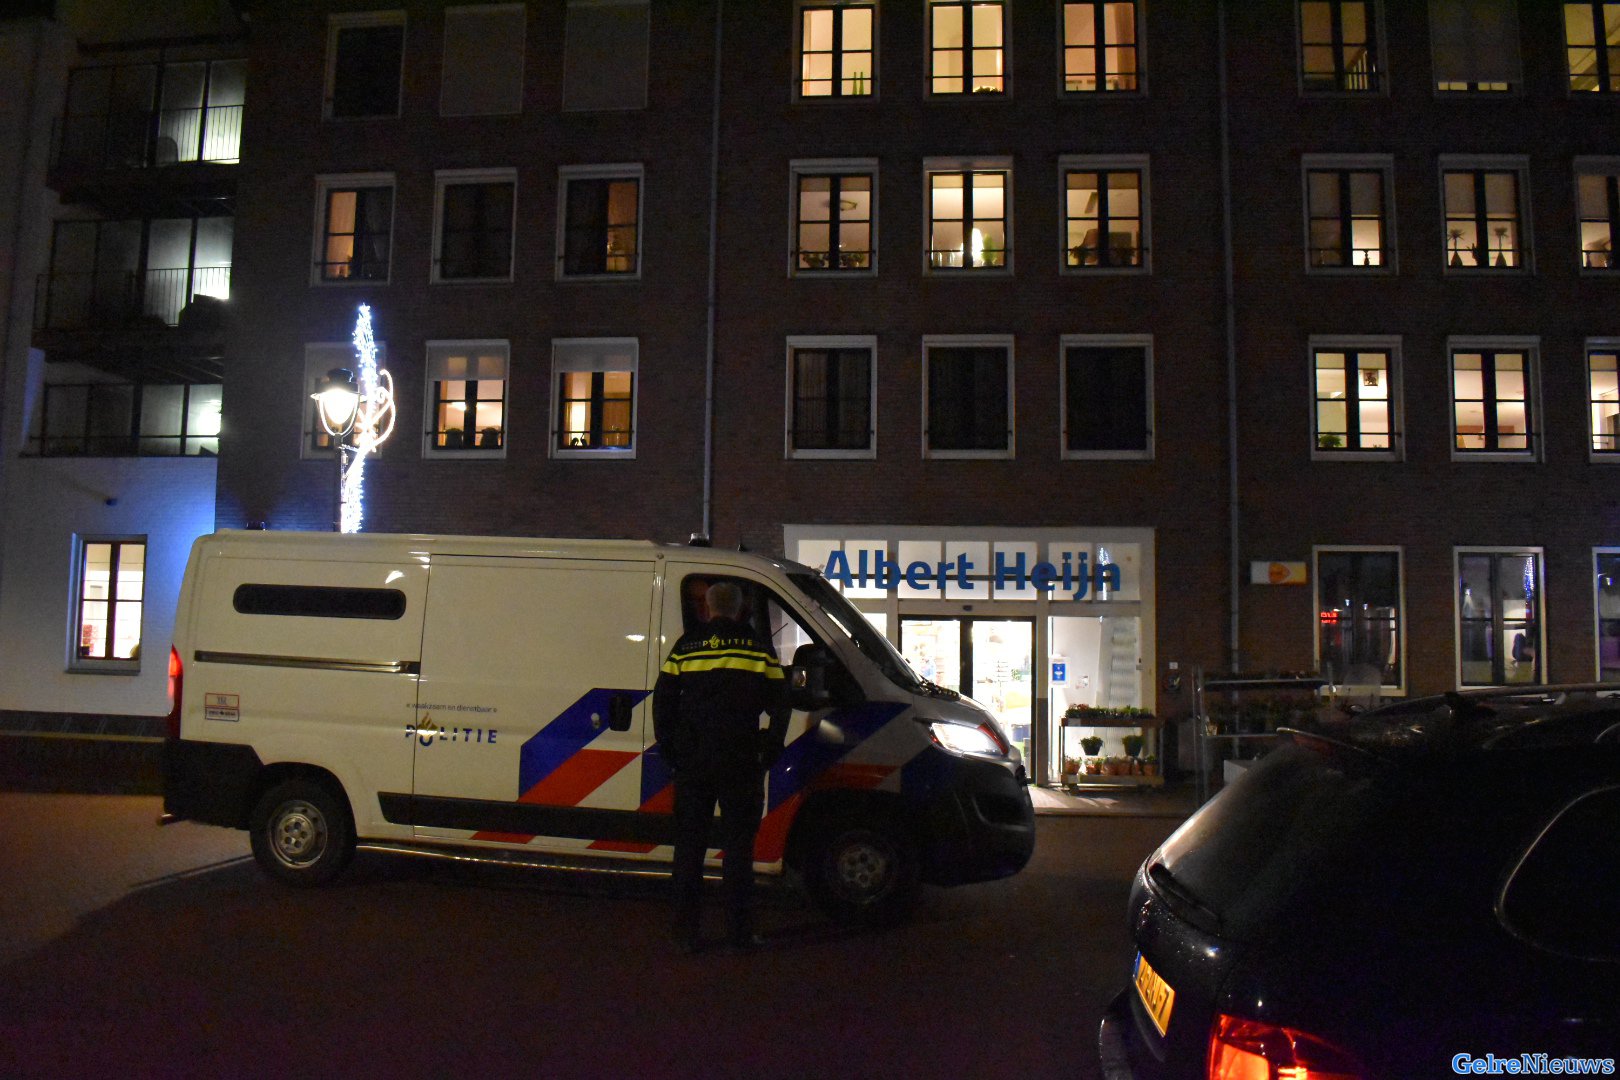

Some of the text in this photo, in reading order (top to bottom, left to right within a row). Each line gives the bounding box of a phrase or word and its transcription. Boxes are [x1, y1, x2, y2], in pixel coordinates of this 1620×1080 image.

[823, 549, 1120, 601] Albert Heijn
[702, 635, 753, 648] POLITIE
[405, 722, 498, 747] POLITIE
